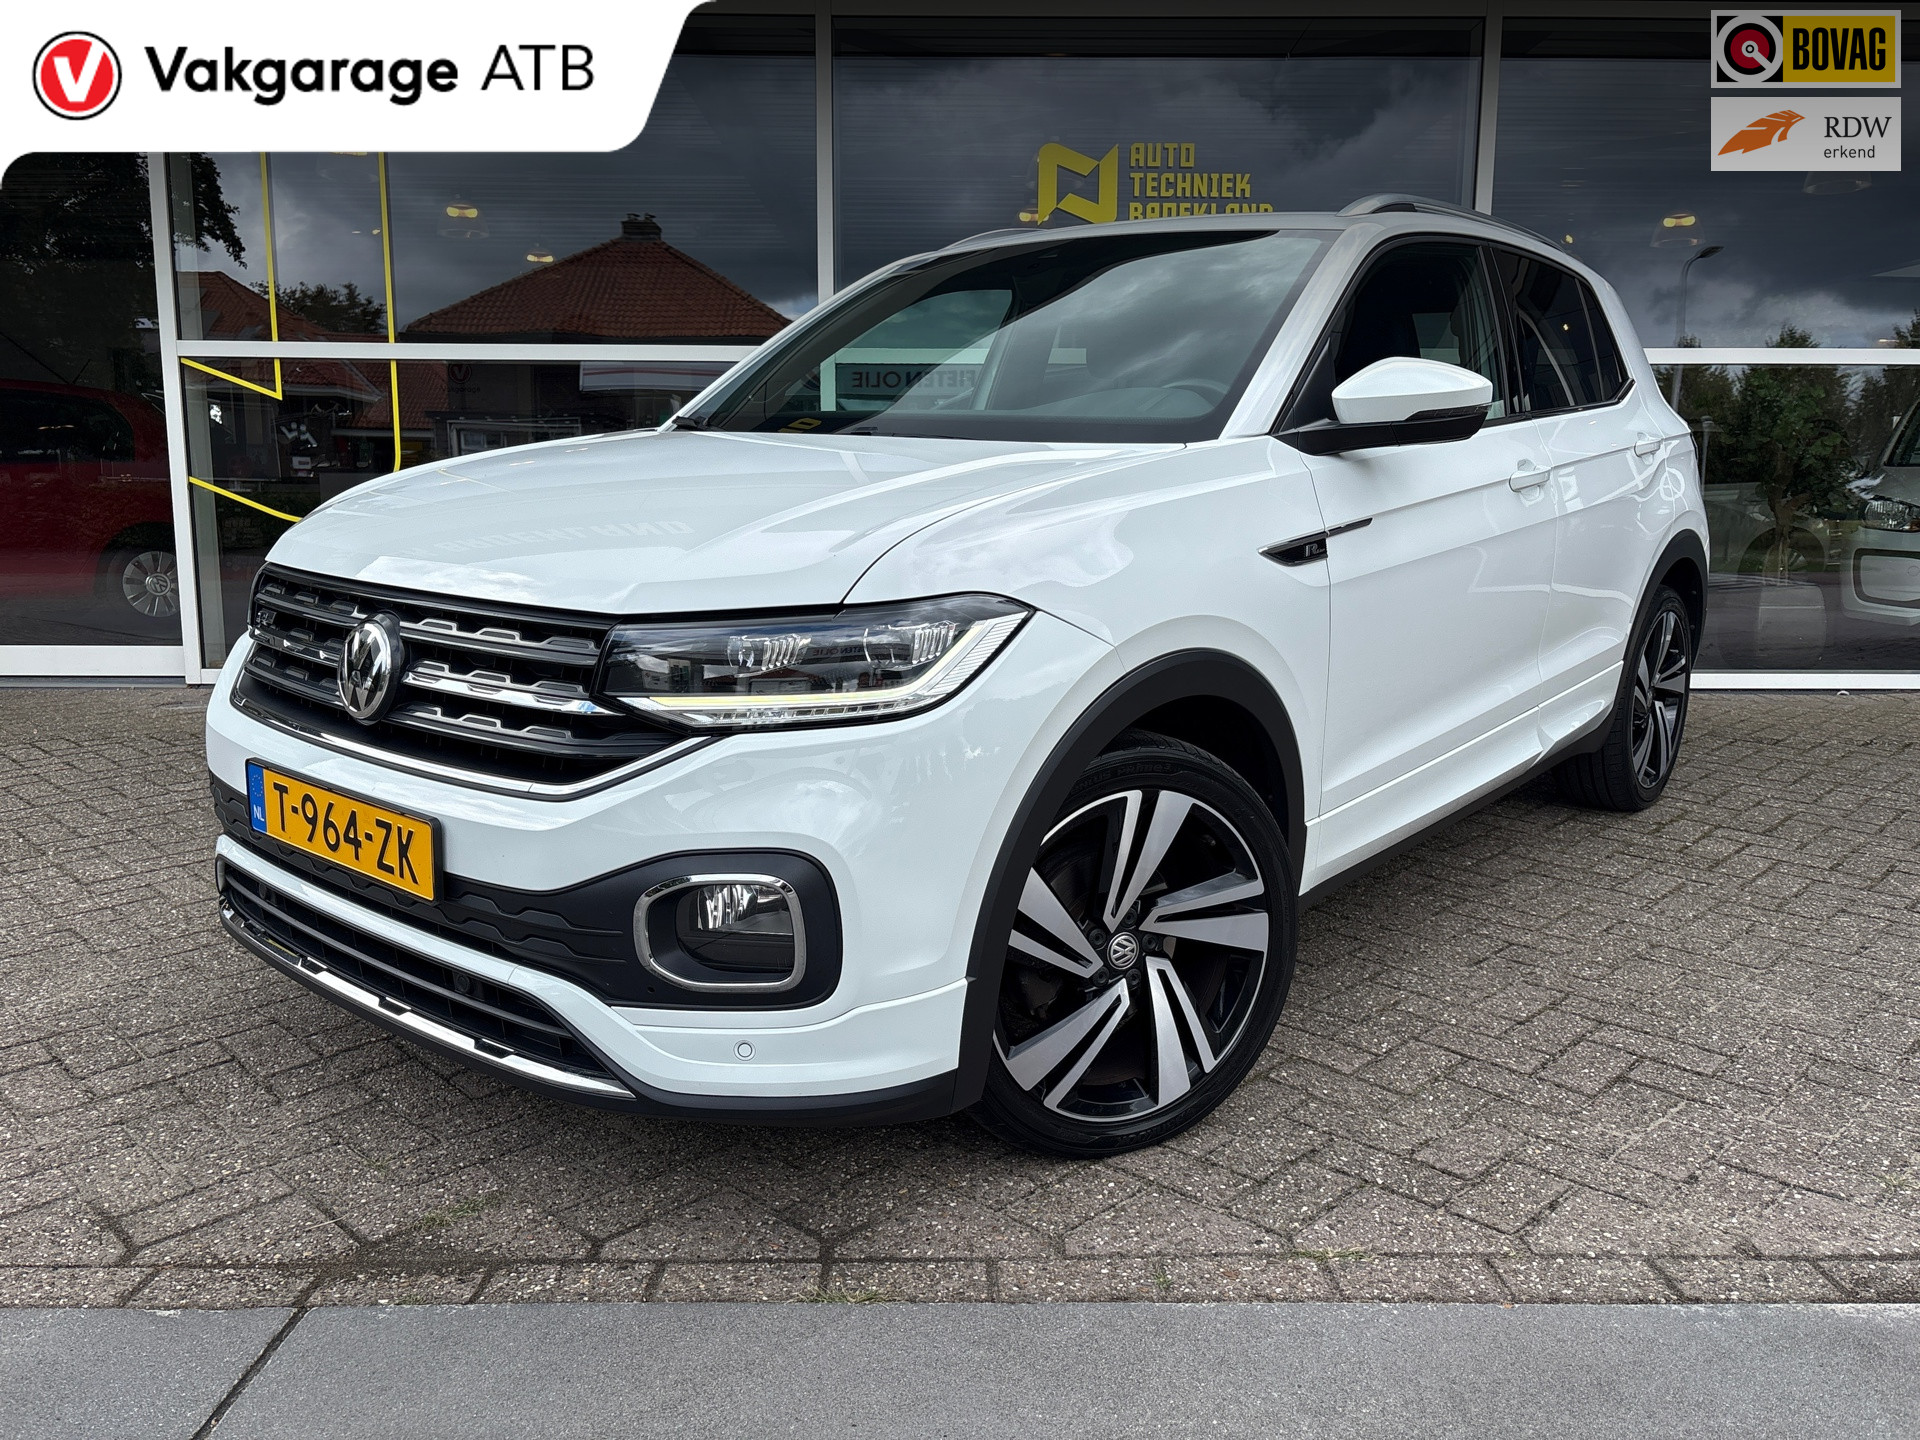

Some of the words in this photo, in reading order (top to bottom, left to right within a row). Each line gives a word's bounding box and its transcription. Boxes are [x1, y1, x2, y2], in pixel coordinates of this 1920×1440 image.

[1129, 142, 1195, 168] AUTO
[1129, 173, 1251, 198] TECHNIEK
[253, 804, 265, 822] NL
[272, 781, 419, 886] T-964-ZK
